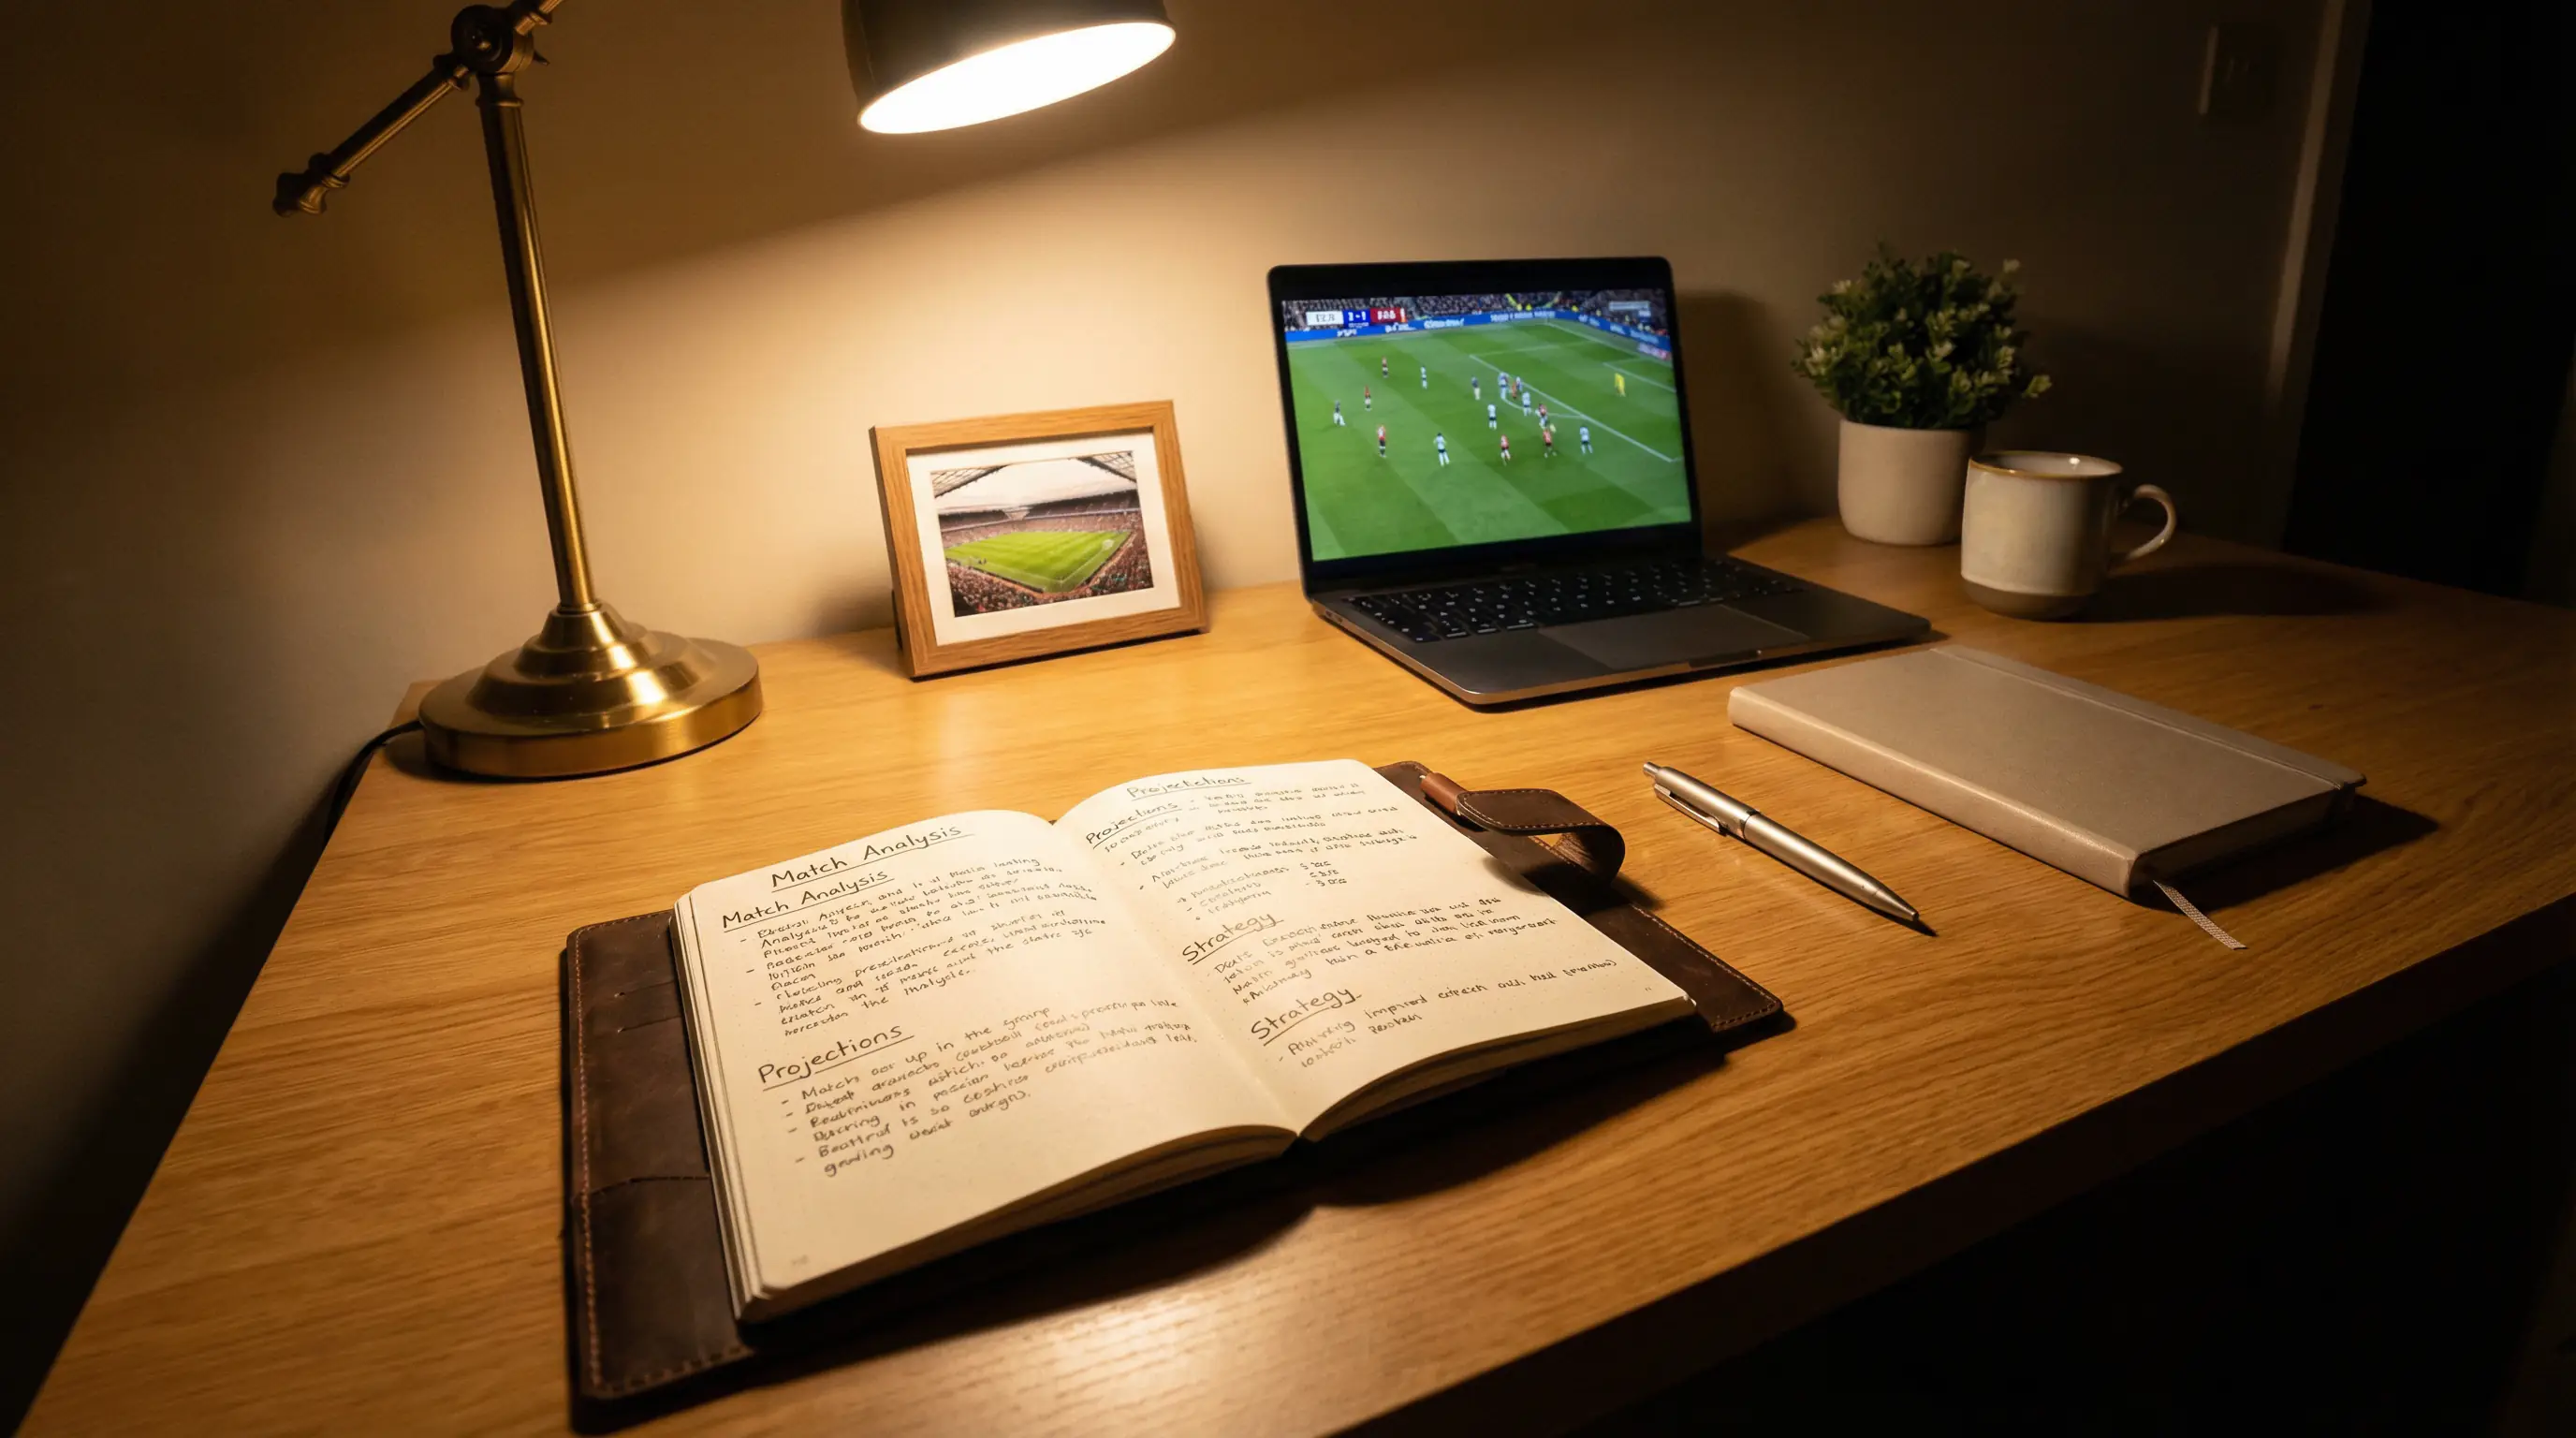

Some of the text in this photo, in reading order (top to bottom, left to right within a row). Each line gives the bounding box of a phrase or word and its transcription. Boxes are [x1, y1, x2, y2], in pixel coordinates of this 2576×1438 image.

[1086, 802, 1178, 844] Projections
[771, 827, 962, 888] Match Analysis
[722, 900, 789, 929] Match
[800, 871, 889, 904] Analysis
[1182, 913, 1278, 962] Strategy
[1251, 988, 1357, 1040] Strategy
[757, 1026, 903, 1084] Projections
[801, 1076, 860, 1100] Match
[965, 1026, 992, 1041] the
